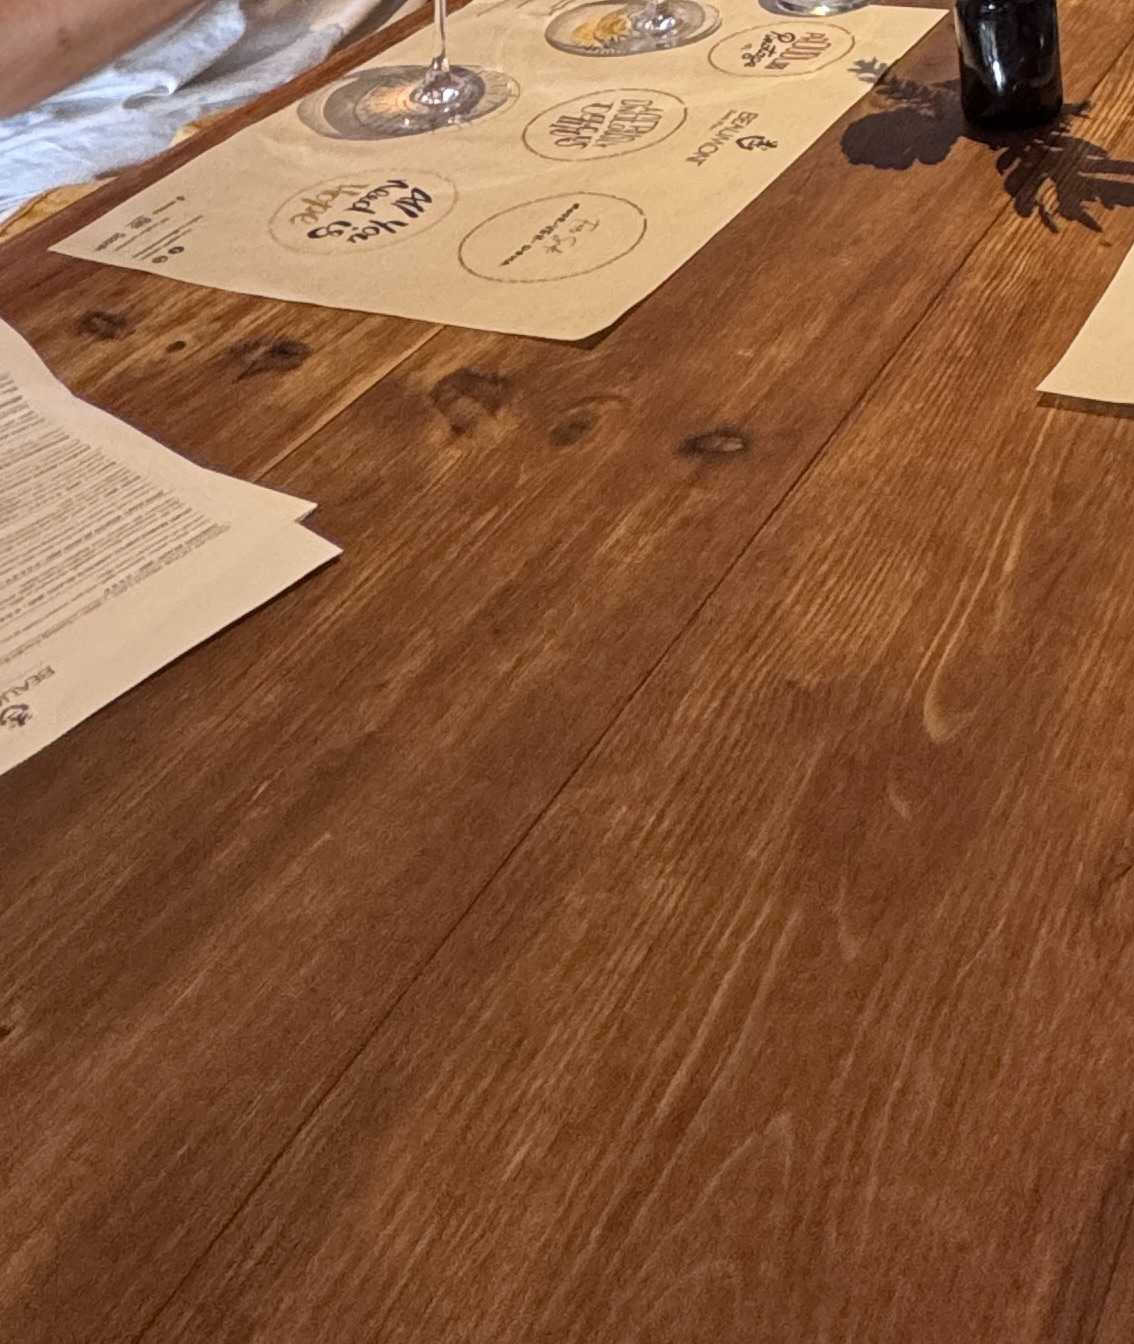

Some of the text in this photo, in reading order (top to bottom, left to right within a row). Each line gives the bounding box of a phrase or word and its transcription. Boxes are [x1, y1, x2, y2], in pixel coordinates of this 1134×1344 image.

[742, 30, 796, 68] Pinotage
[686, 111, 758, 166] BEAUMONT
[289, 183, 370, 225] Hope
[346, 186, 433, 244] All You
[306, 220, 359, 240] is
